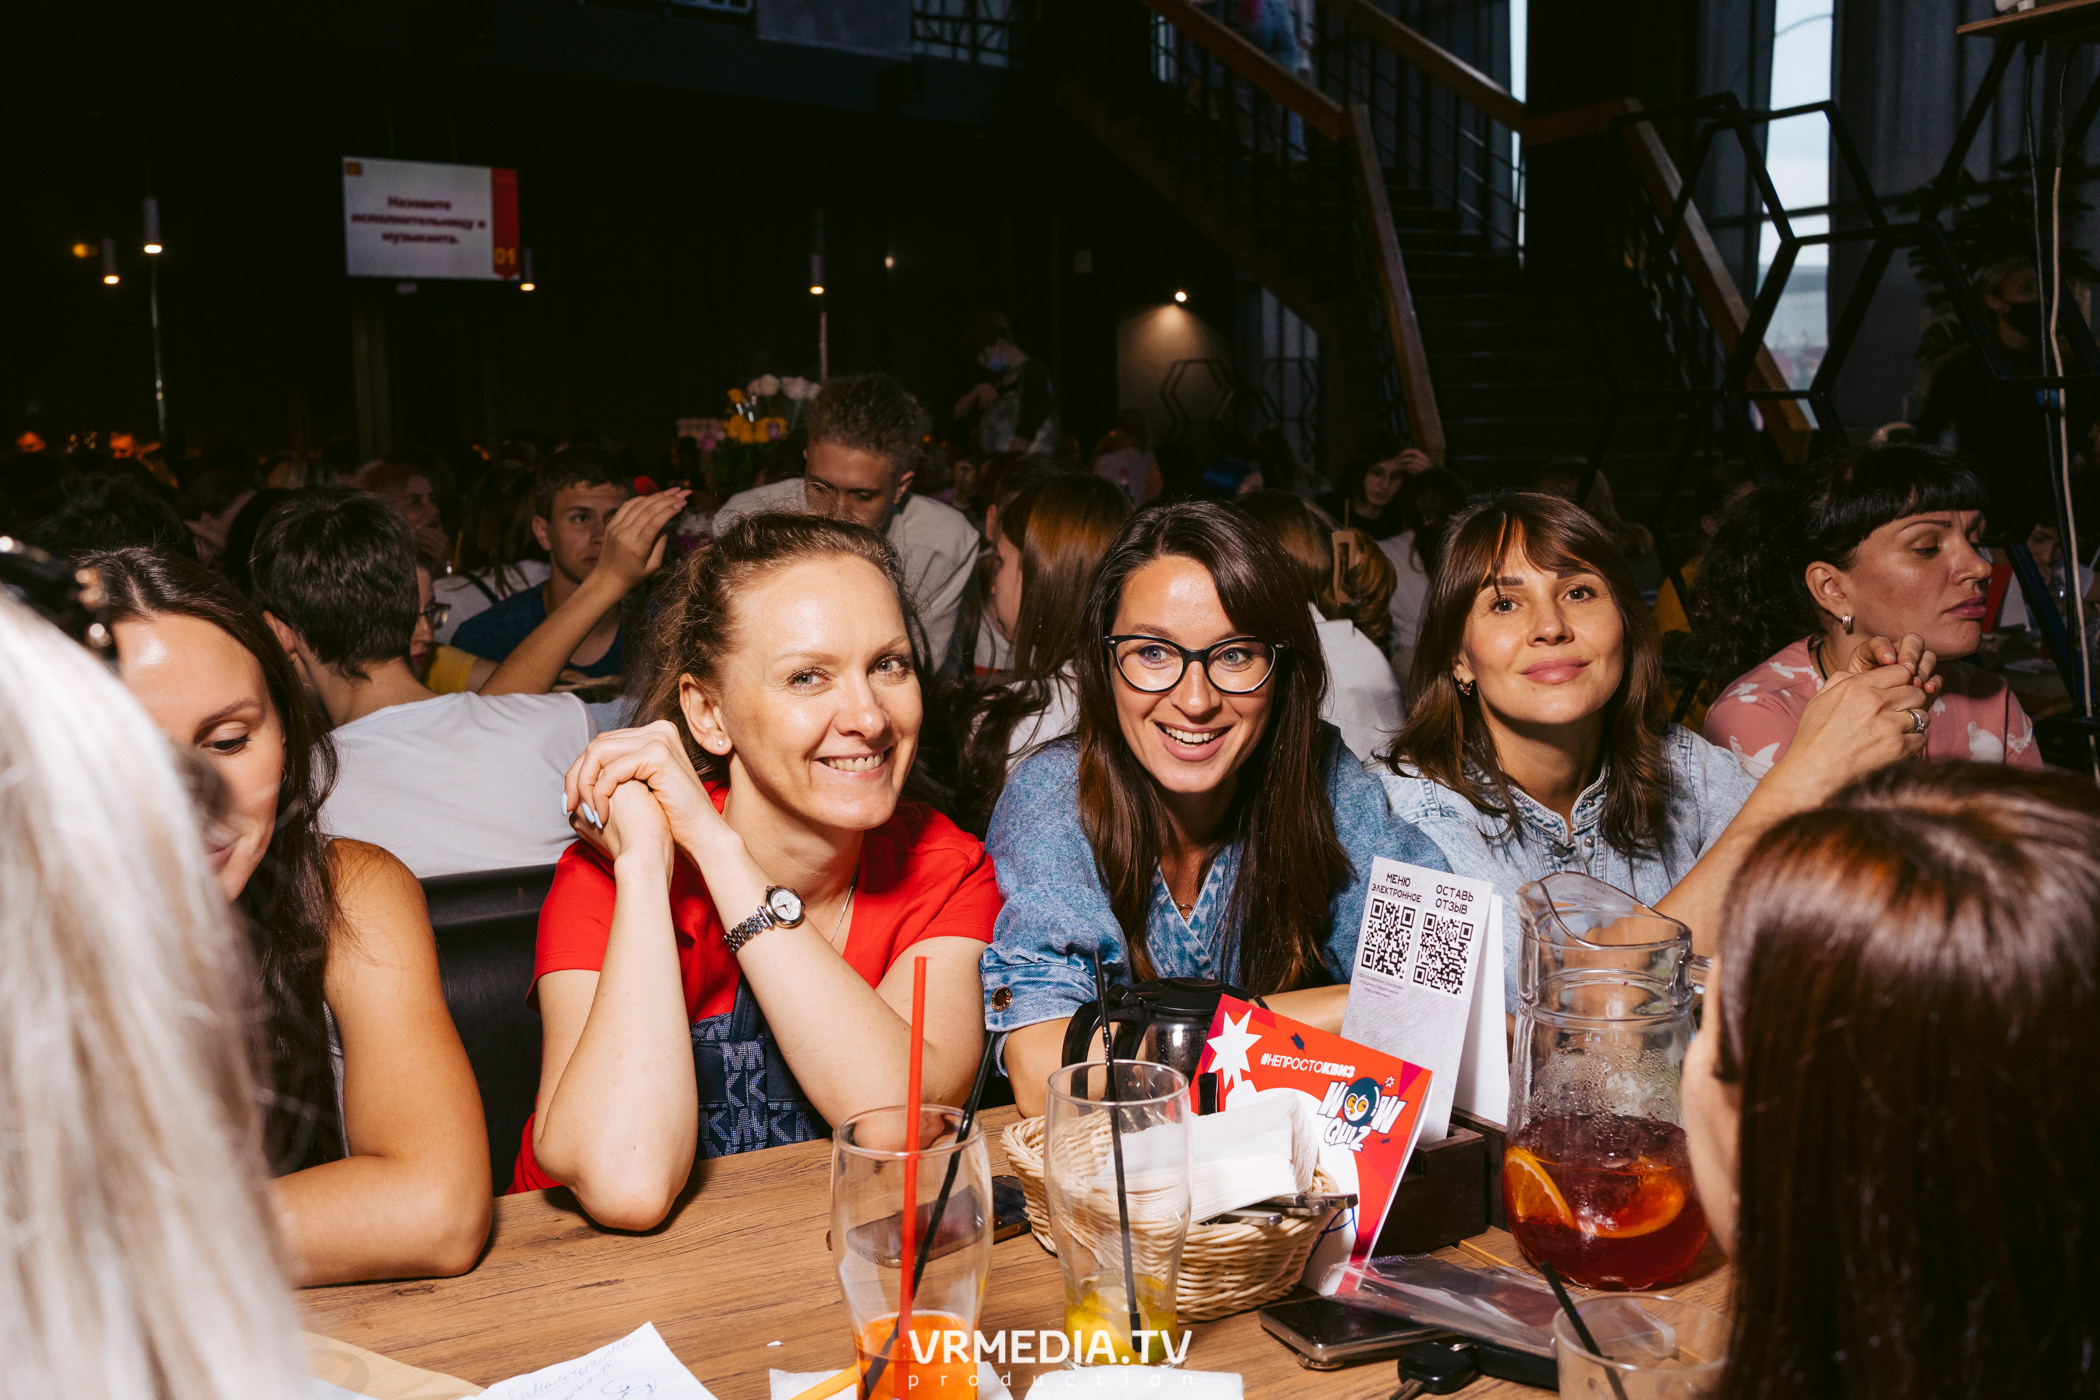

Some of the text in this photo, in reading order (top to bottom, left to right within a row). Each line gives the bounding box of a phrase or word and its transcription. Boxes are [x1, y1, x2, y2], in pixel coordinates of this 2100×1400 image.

[494, 247, 516, 266] 01
[1386, 872, 1411, 888] МЕНЮ
[1371, 883, 1422, 904] ЭЛЕКТРОННОЕ
[1435, 884, 1474, 903] ОСТАВЬ
[1435, 898, 1468, 915] ОТЗЫВ
[1260, 1053, 1356, 1078] #НЕПРОСТОКВИЗ
[1324, 1117, 1372, 1152] QUIZ
